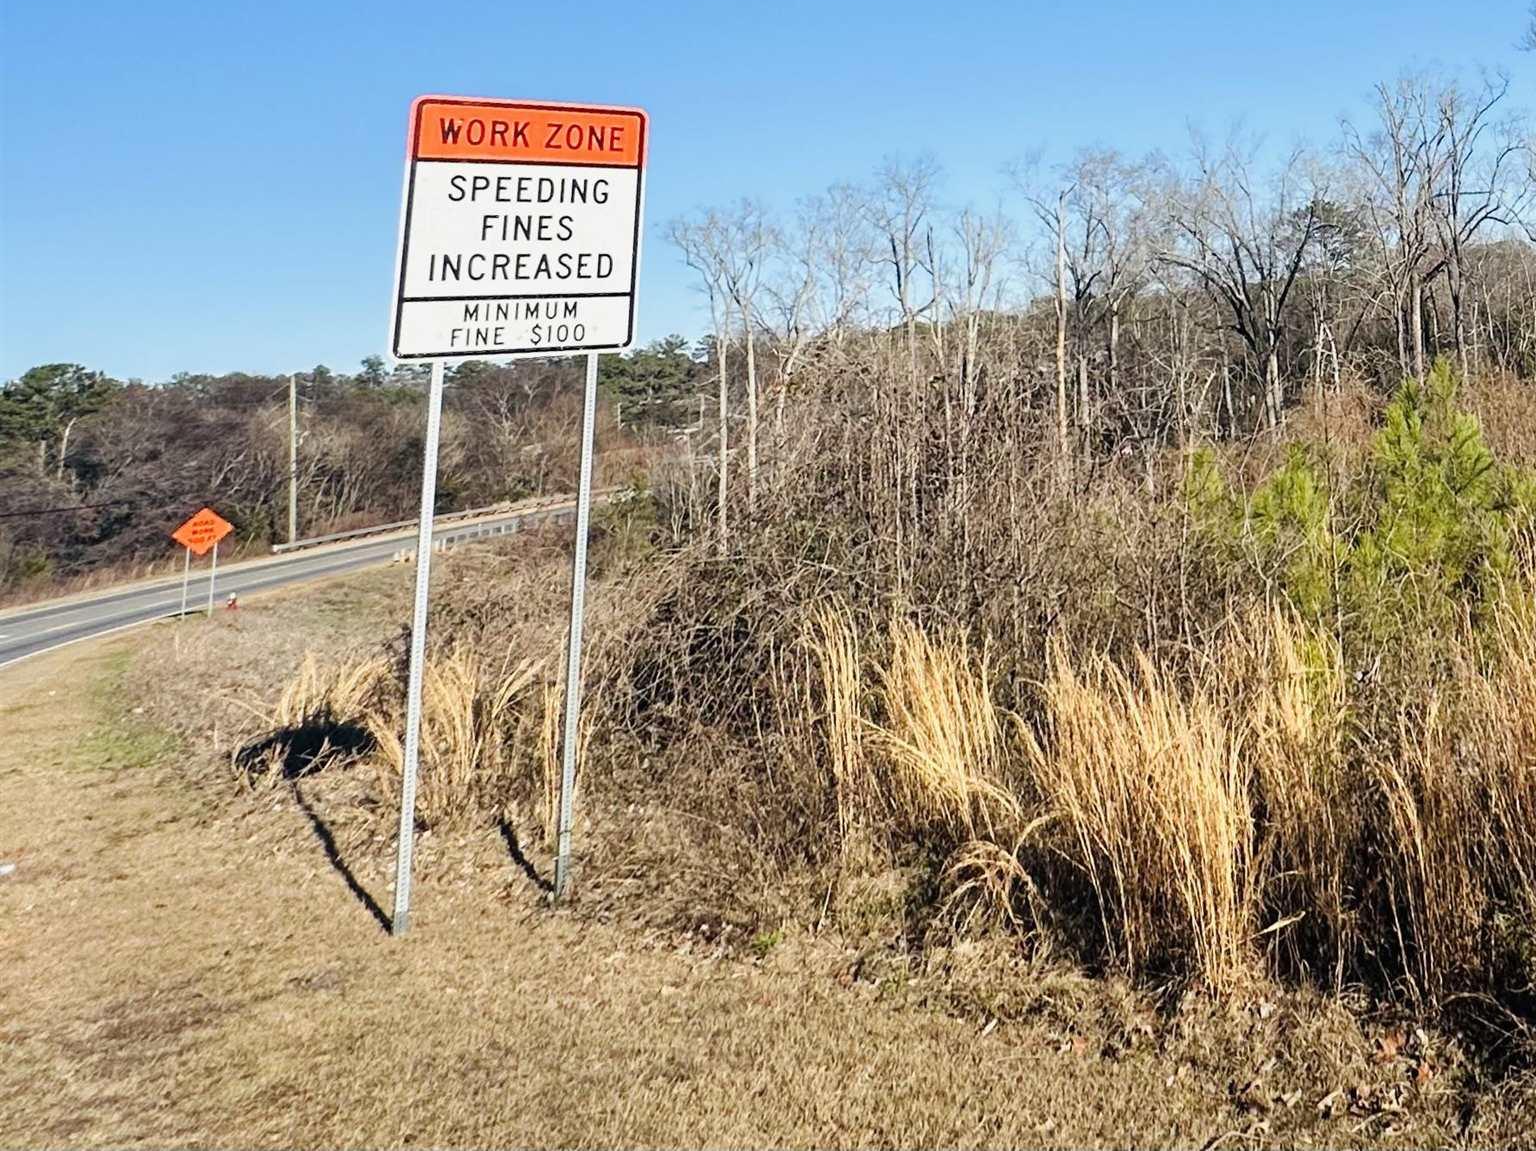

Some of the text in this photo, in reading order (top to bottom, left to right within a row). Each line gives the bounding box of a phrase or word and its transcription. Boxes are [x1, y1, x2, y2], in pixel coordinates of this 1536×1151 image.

[440, 118, 625, 152] WORK ZONE
[448, 175, 610, 204] SPEEDING
[481, 215, 574, 241] FINES
[428, 253, 613, 281] INCREASED
[463, 301, 578, 322] MINIMUM
[450, 324, 586, 347] FINE $100
